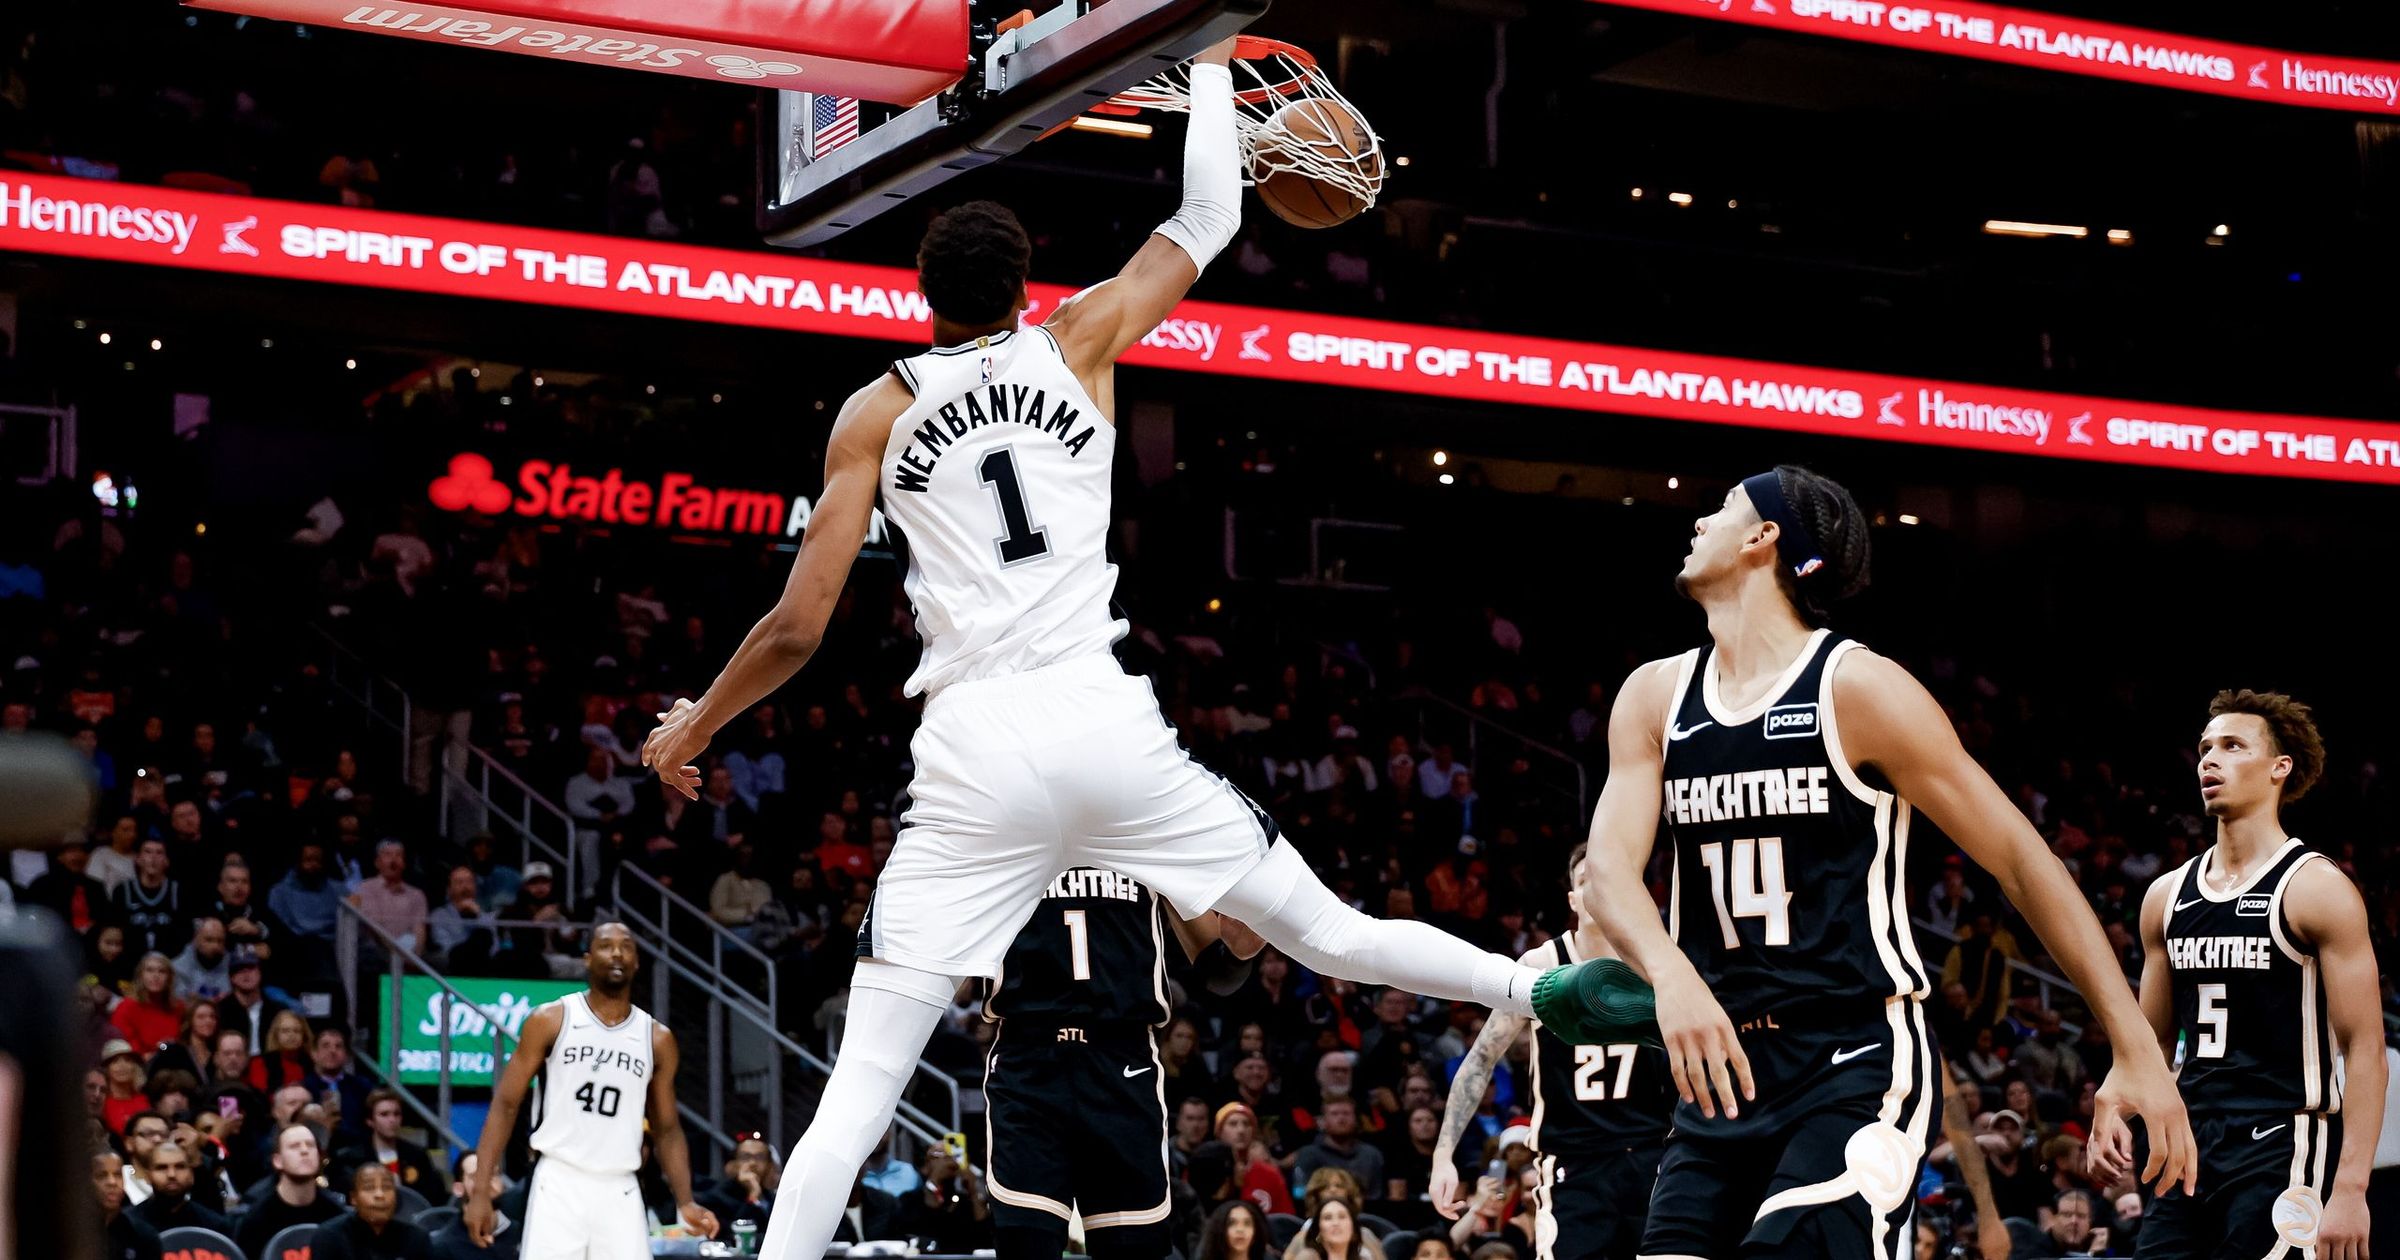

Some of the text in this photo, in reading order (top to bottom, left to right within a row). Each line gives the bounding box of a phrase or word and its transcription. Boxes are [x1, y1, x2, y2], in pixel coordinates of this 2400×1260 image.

[1790, 0, 2235, 81] SPIRIT OF THE ATLANTA HAWKS
[2281, 58, 2400, 106] Hennessy
[0, 182, 198, 255] Hennessy
[280, 223, 930, 322] SPIRIT OF THE ATLANTA HAW
[1287, 331, 1864, 420] SPIRIT OF THE ATLANTA HAWKS
[894, 384, 1096, 493] WEMBANYAMA
[1918, 388, 2053, 446] Hennessy
[2105, 416, 2209, 453] SPIRIT
[2212, 428, 2260, 457] OF
[2263, 430, 2337, 463] THE
[513, 458, 654, 526] State
[655, 471, 785, 536] Farm
[974, 442, 1055, 571] 1
[1769, 711, 1815, 732] paze
[1664, 766, 1829, 826] PEACHTREE
[1700, 836, 1794, 950] 14
[2239, 899, 2269, 911] paze
[1063, 909, 1091, 981] 1
[2166, 936, 2271, 970] PEACHTREE
[1056, 1027, 1088, 1044] ATL
[2196, 983, 2228, 1059] 5
[564, 1045, 646, 1078] SPURS
[1574, 1043, 1639, 1101] 27
[575, 1081, 621, 1118] 40
